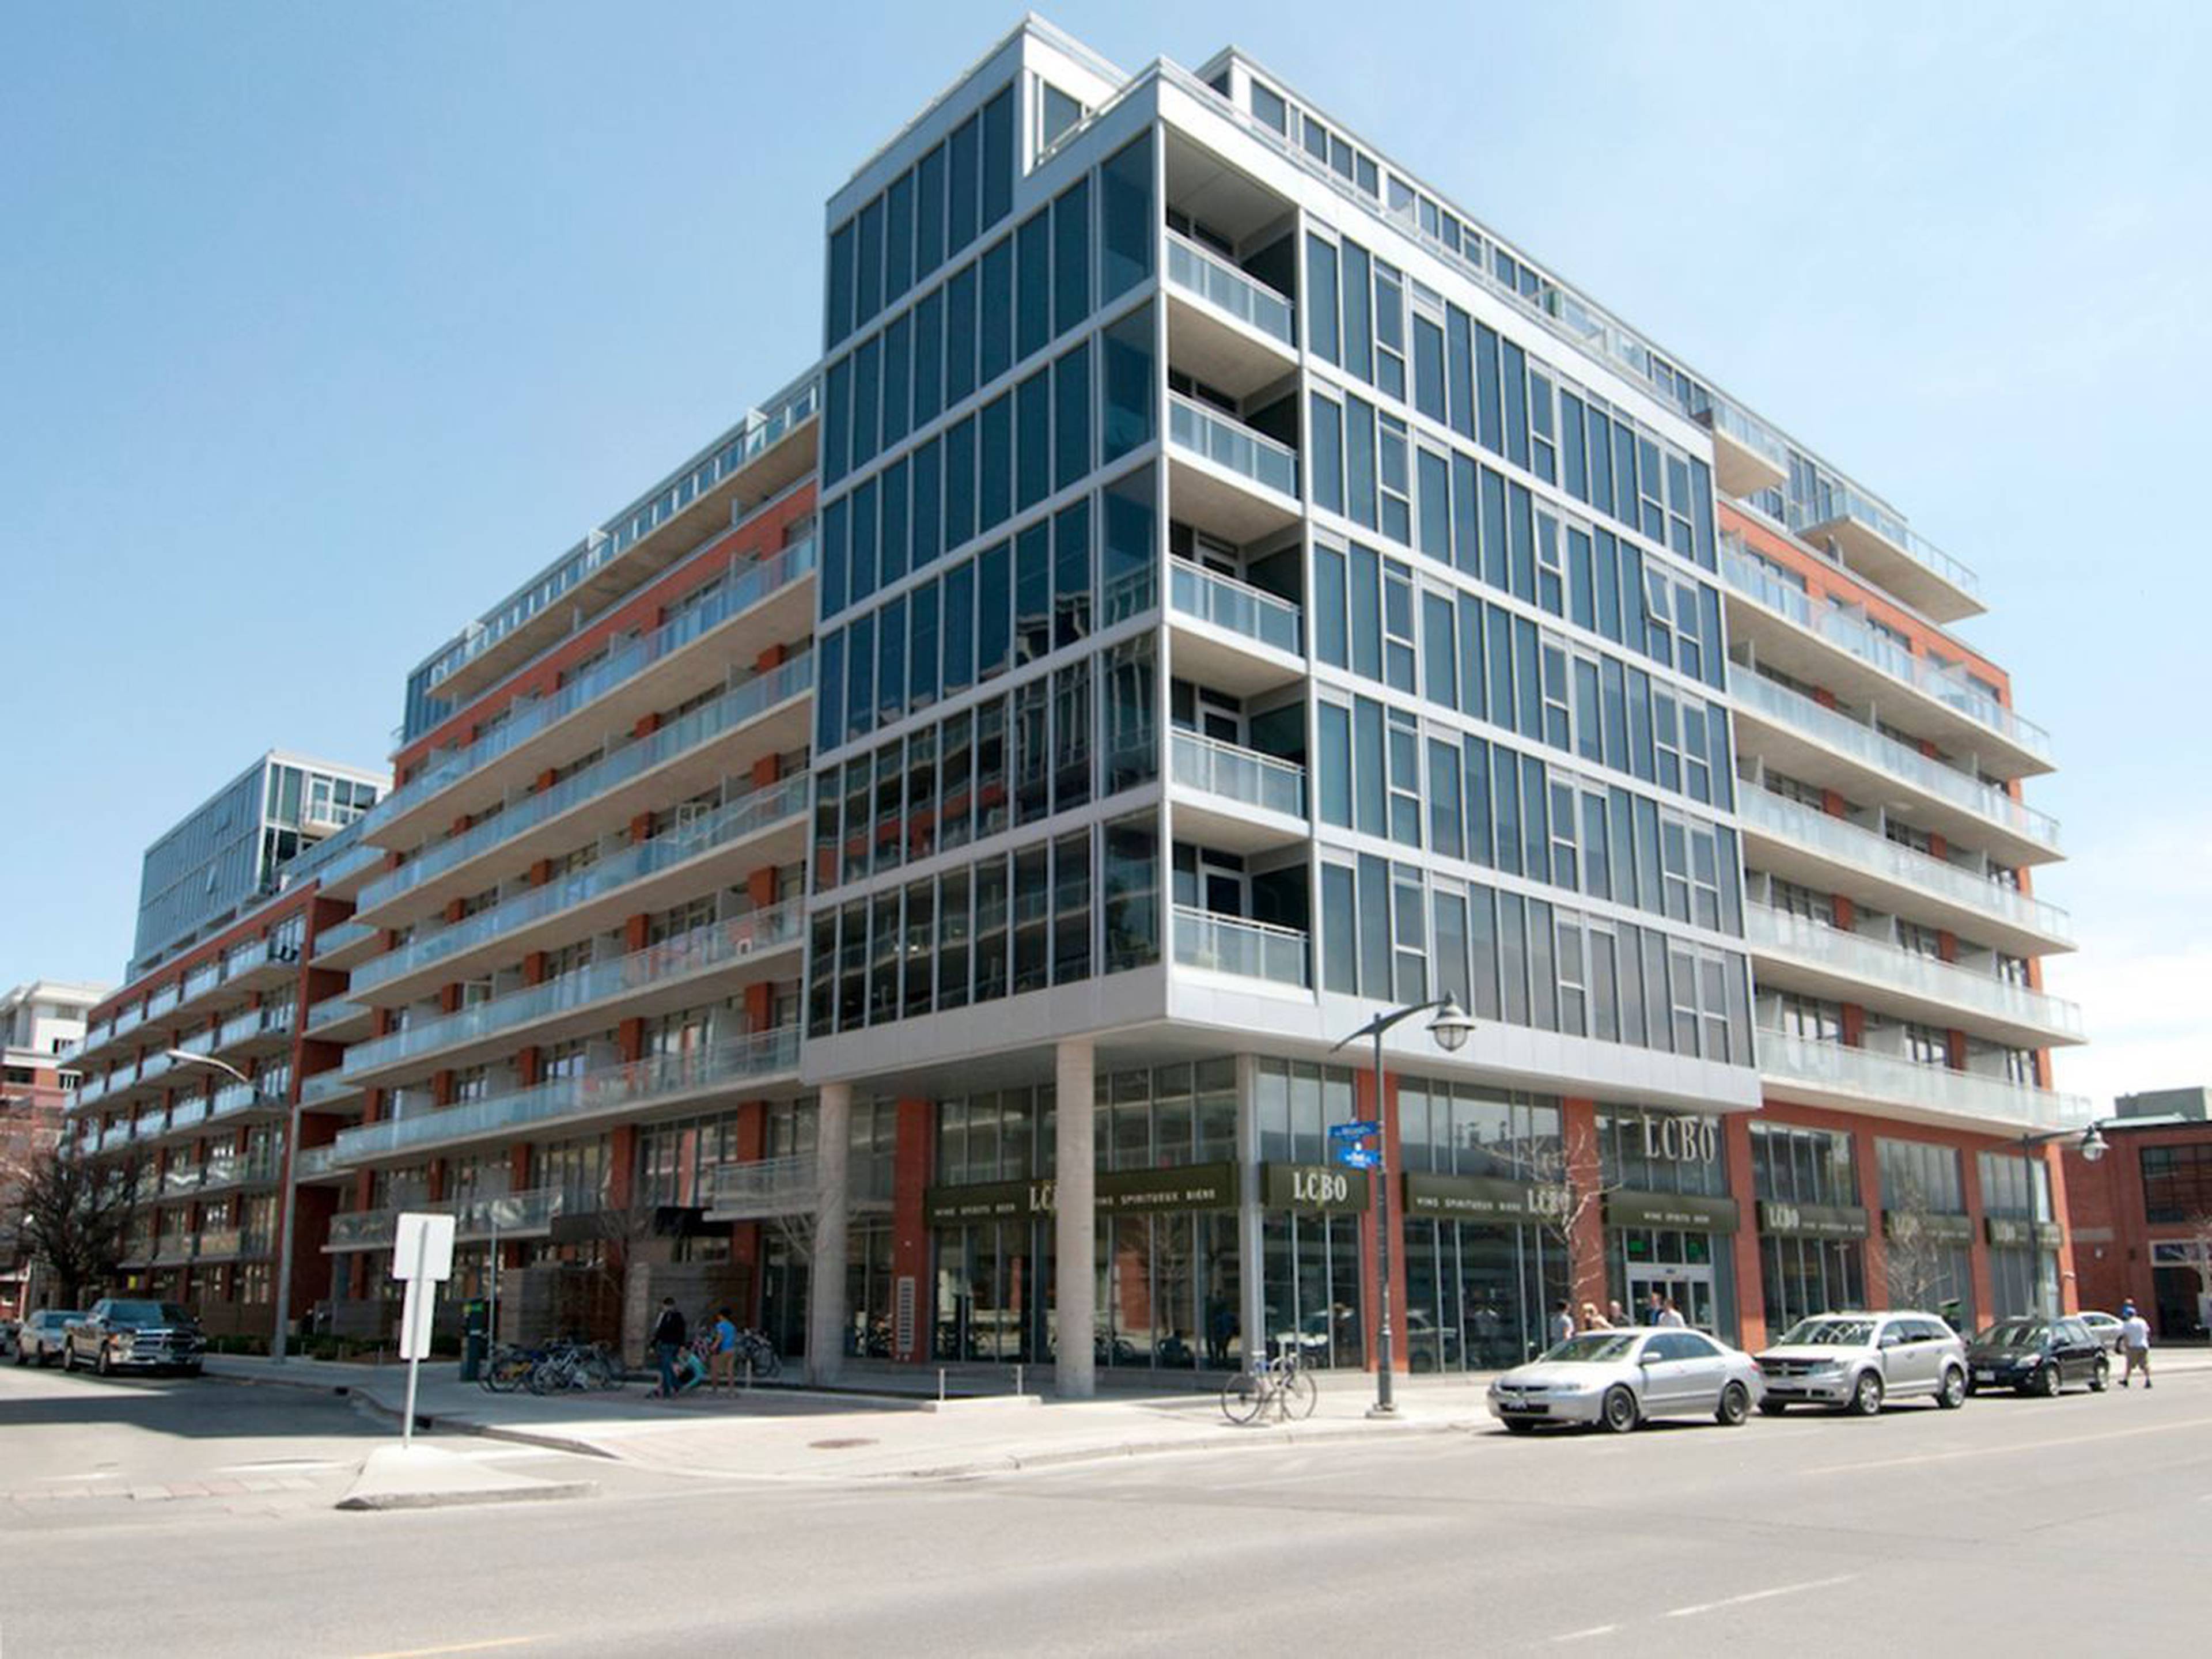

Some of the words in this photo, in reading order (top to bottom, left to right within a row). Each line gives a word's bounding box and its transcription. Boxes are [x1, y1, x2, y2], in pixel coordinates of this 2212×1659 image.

[1643, 1115, 1715, 1164] LCBO
[1029, 1185, 1055, 1210] LC
[1294, 1172, 1347, 1202] LCBO
